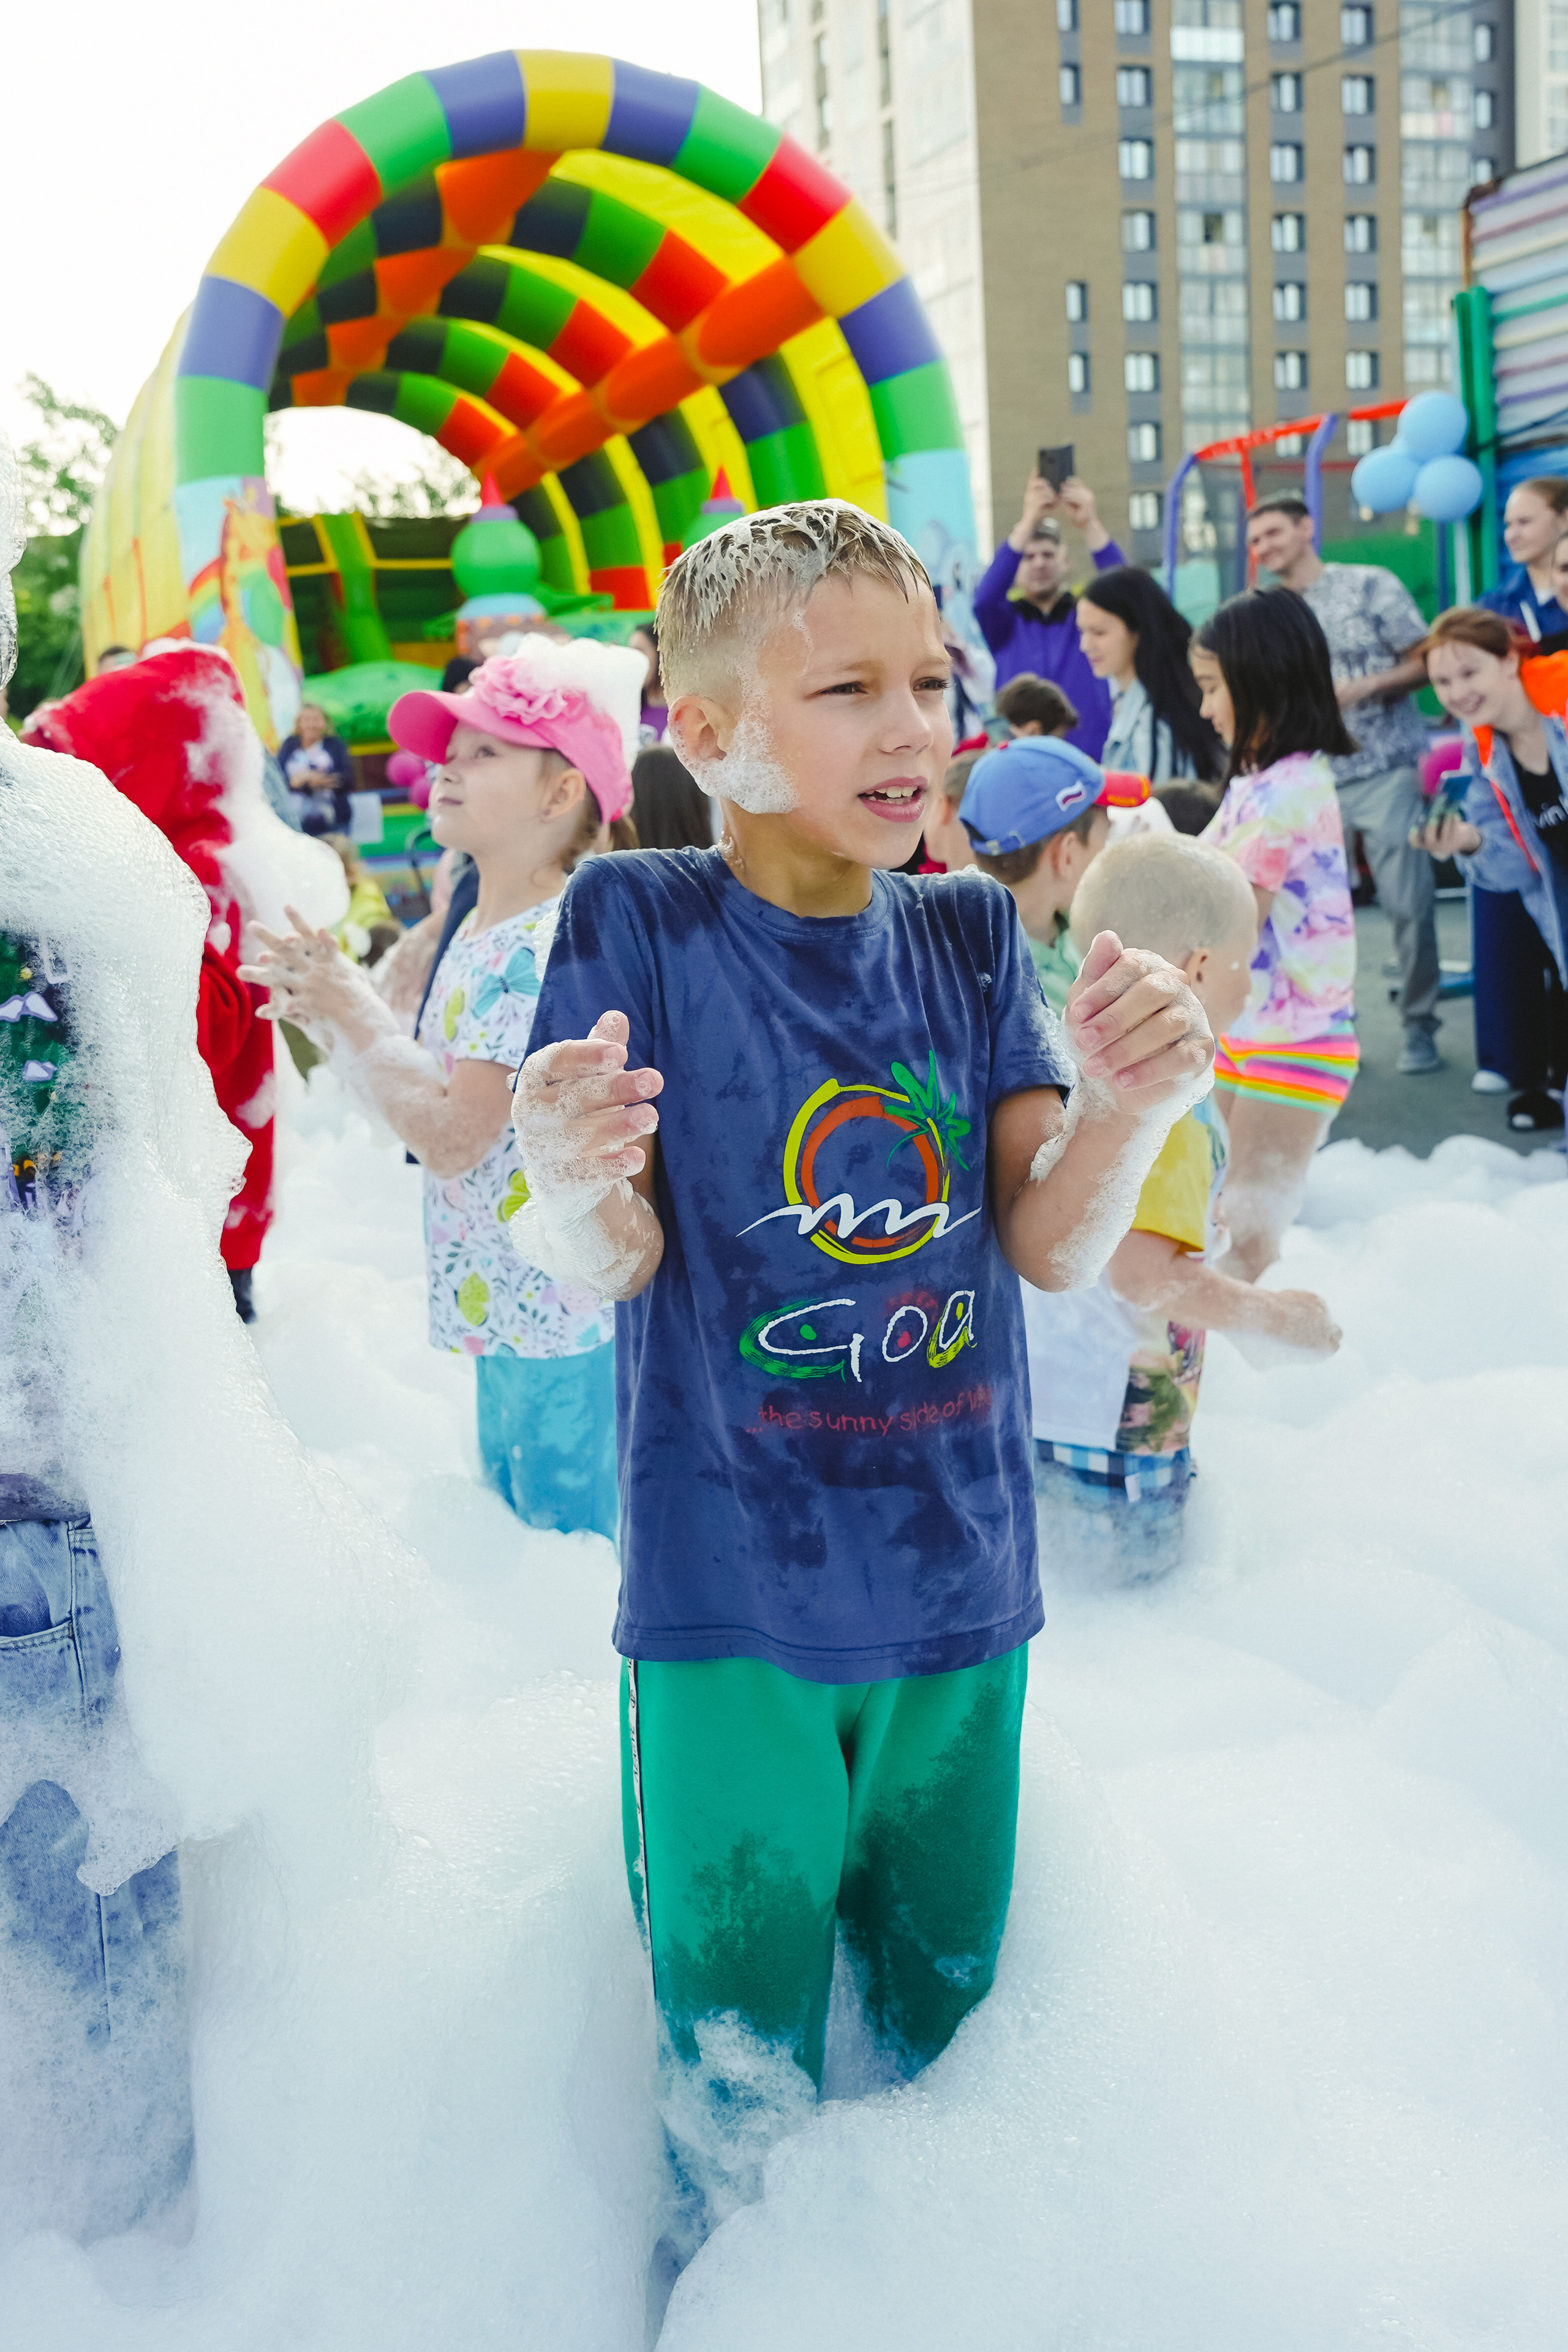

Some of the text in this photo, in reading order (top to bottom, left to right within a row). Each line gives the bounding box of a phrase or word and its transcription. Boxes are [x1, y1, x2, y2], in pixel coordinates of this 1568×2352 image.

[809, 1411, 893, 1436] sunny
[900, 1401, 939, 1431] side
[943, 1392, 965, 1417] of
